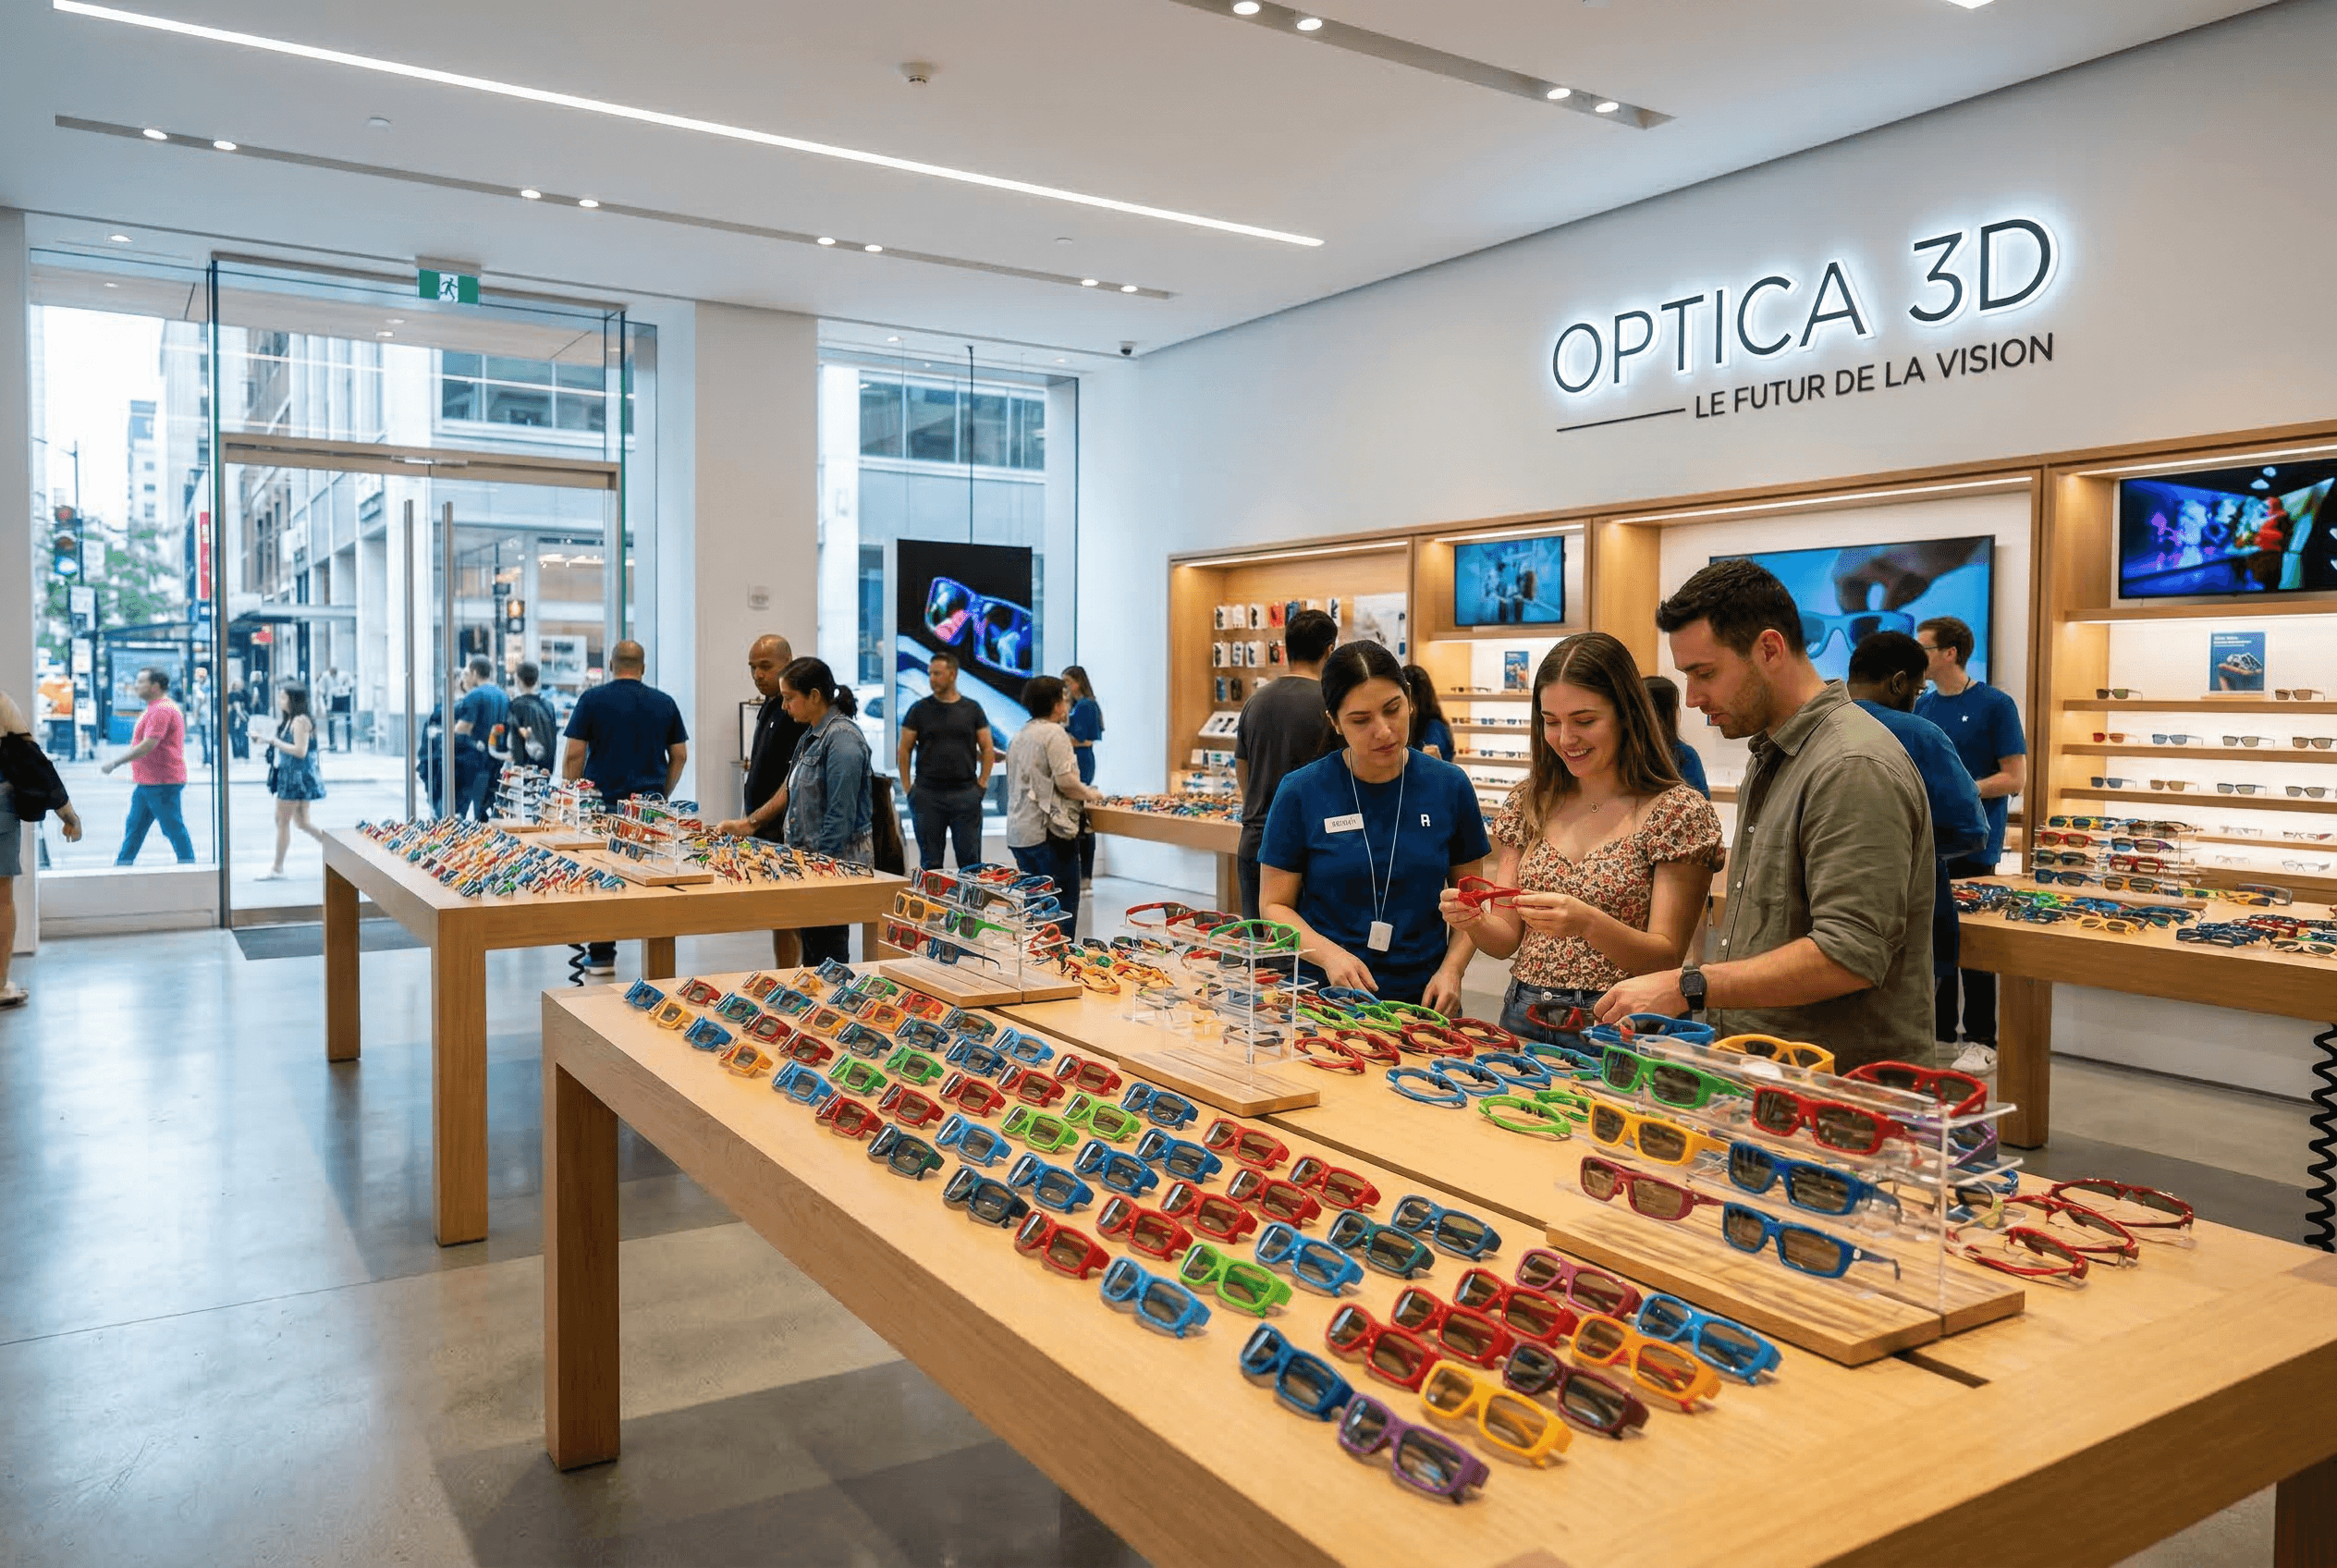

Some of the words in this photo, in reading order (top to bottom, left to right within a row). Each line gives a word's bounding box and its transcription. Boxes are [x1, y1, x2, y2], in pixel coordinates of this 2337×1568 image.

[1552, 262, 1866, 394] OPTICA
[1908, 218, 2051, 323] 3D
[1695, 391, 1726, 420] LE
[1734, 374, 1827, 414] FUTUR
[1835, 364, 1876, 398] DE
[1885, 356, 1927, 389] LA
[1936, 332, 2055, 379] VISION
